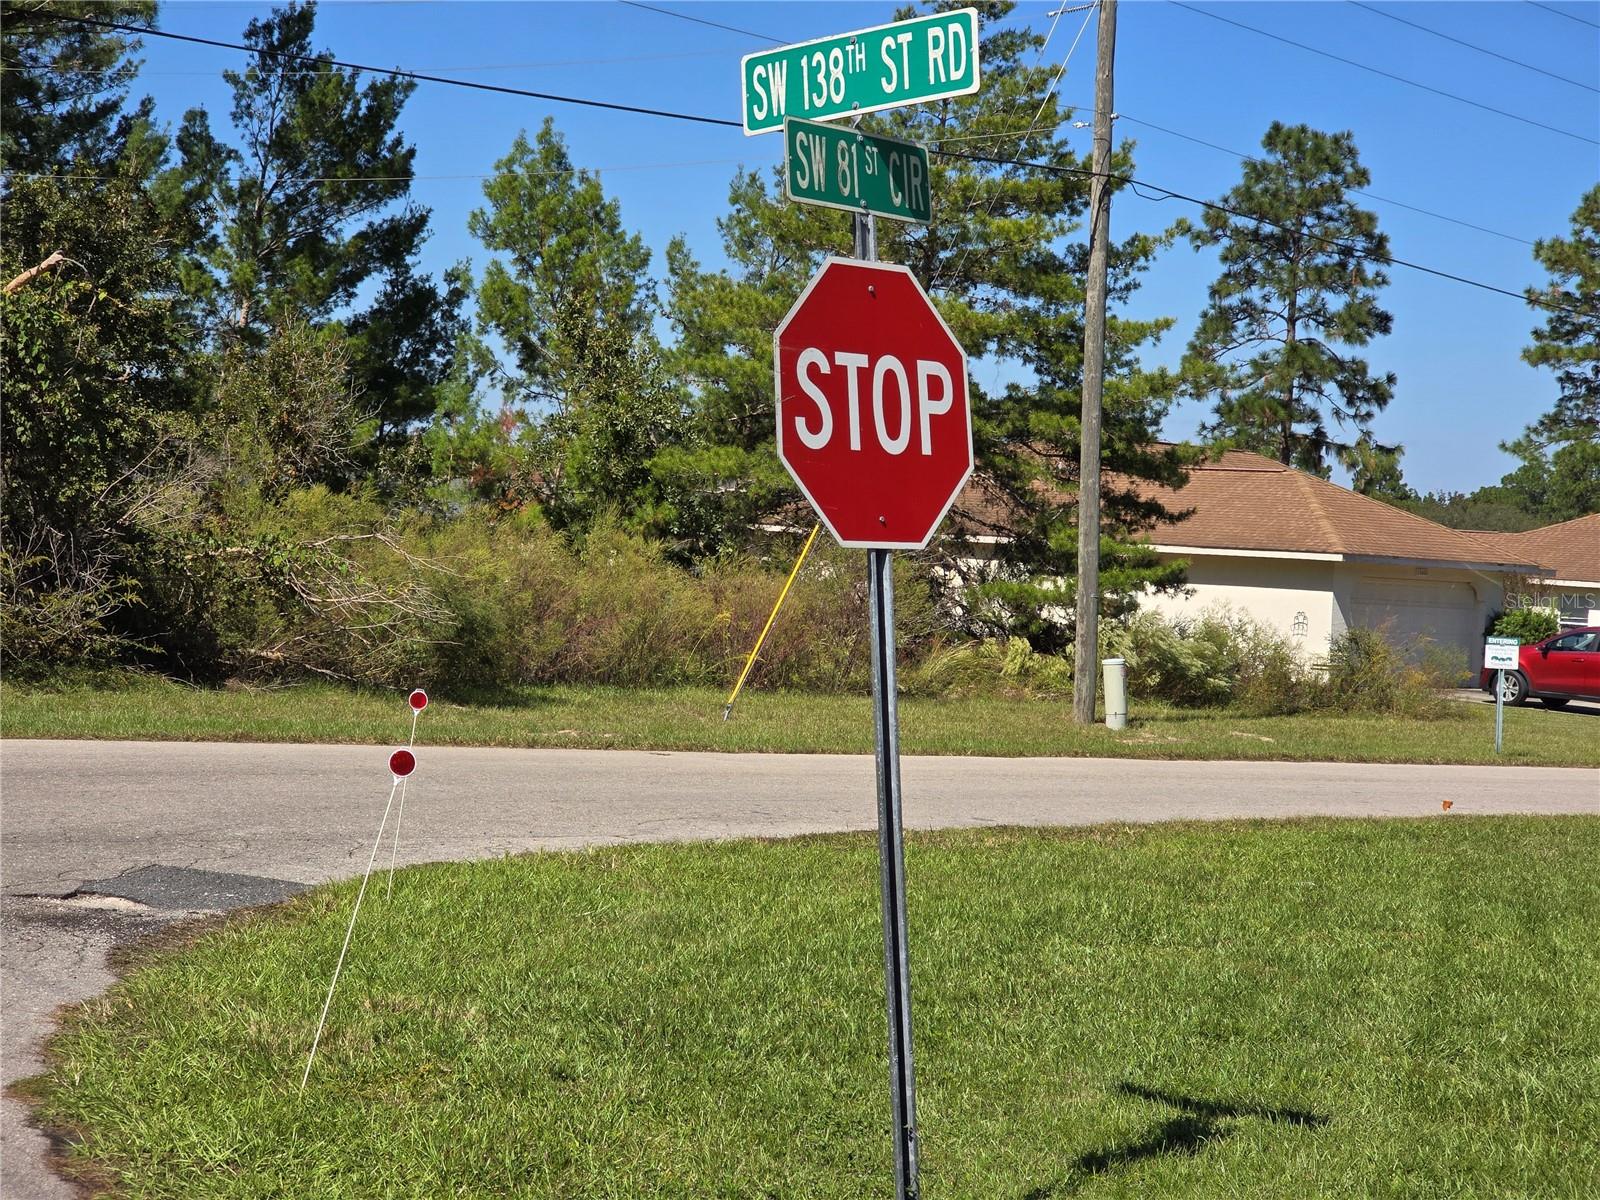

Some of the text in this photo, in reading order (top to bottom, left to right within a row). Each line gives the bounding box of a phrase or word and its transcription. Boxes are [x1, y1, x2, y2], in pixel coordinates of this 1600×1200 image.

[752, 22, 967, 121] SW 138TH ST RD
[795, 131, 924, 211] SW 81ST CIR
[795, 347, 953, 455] STOP
